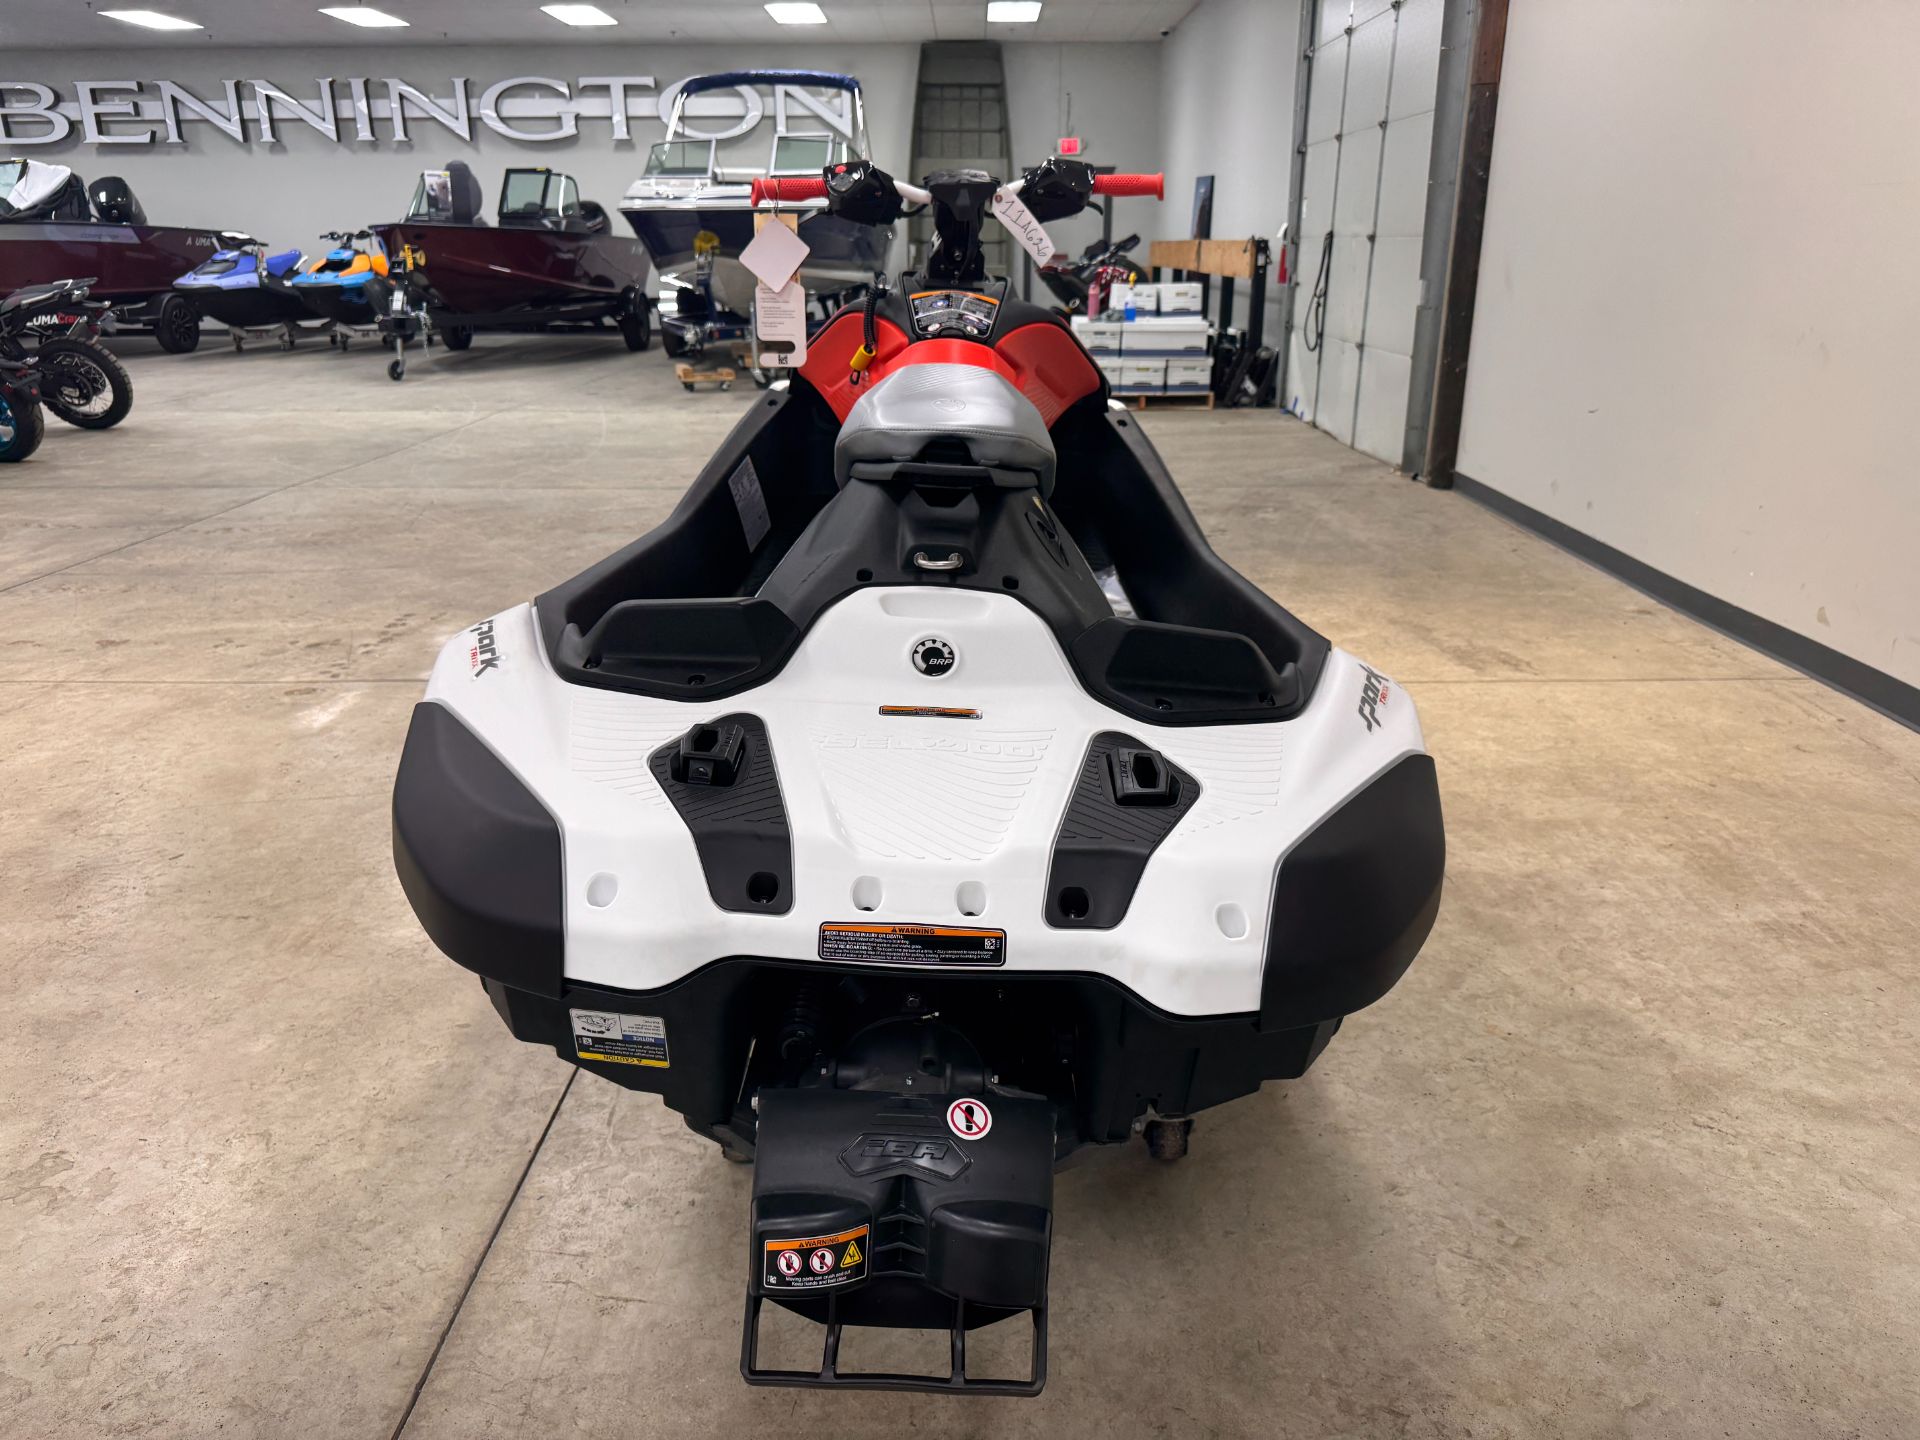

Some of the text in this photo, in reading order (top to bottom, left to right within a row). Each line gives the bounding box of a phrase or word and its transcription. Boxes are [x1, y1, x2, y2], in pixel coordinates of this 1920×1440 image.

[0, 75, 854, 144] BENNINGTON
[928, 658, 953, 666] BRP
[898, 927, 936, 935] WARNING
[603, 1055, 635, 1063] CAUTION
[804, 1237, 840, 1247] WARNING
